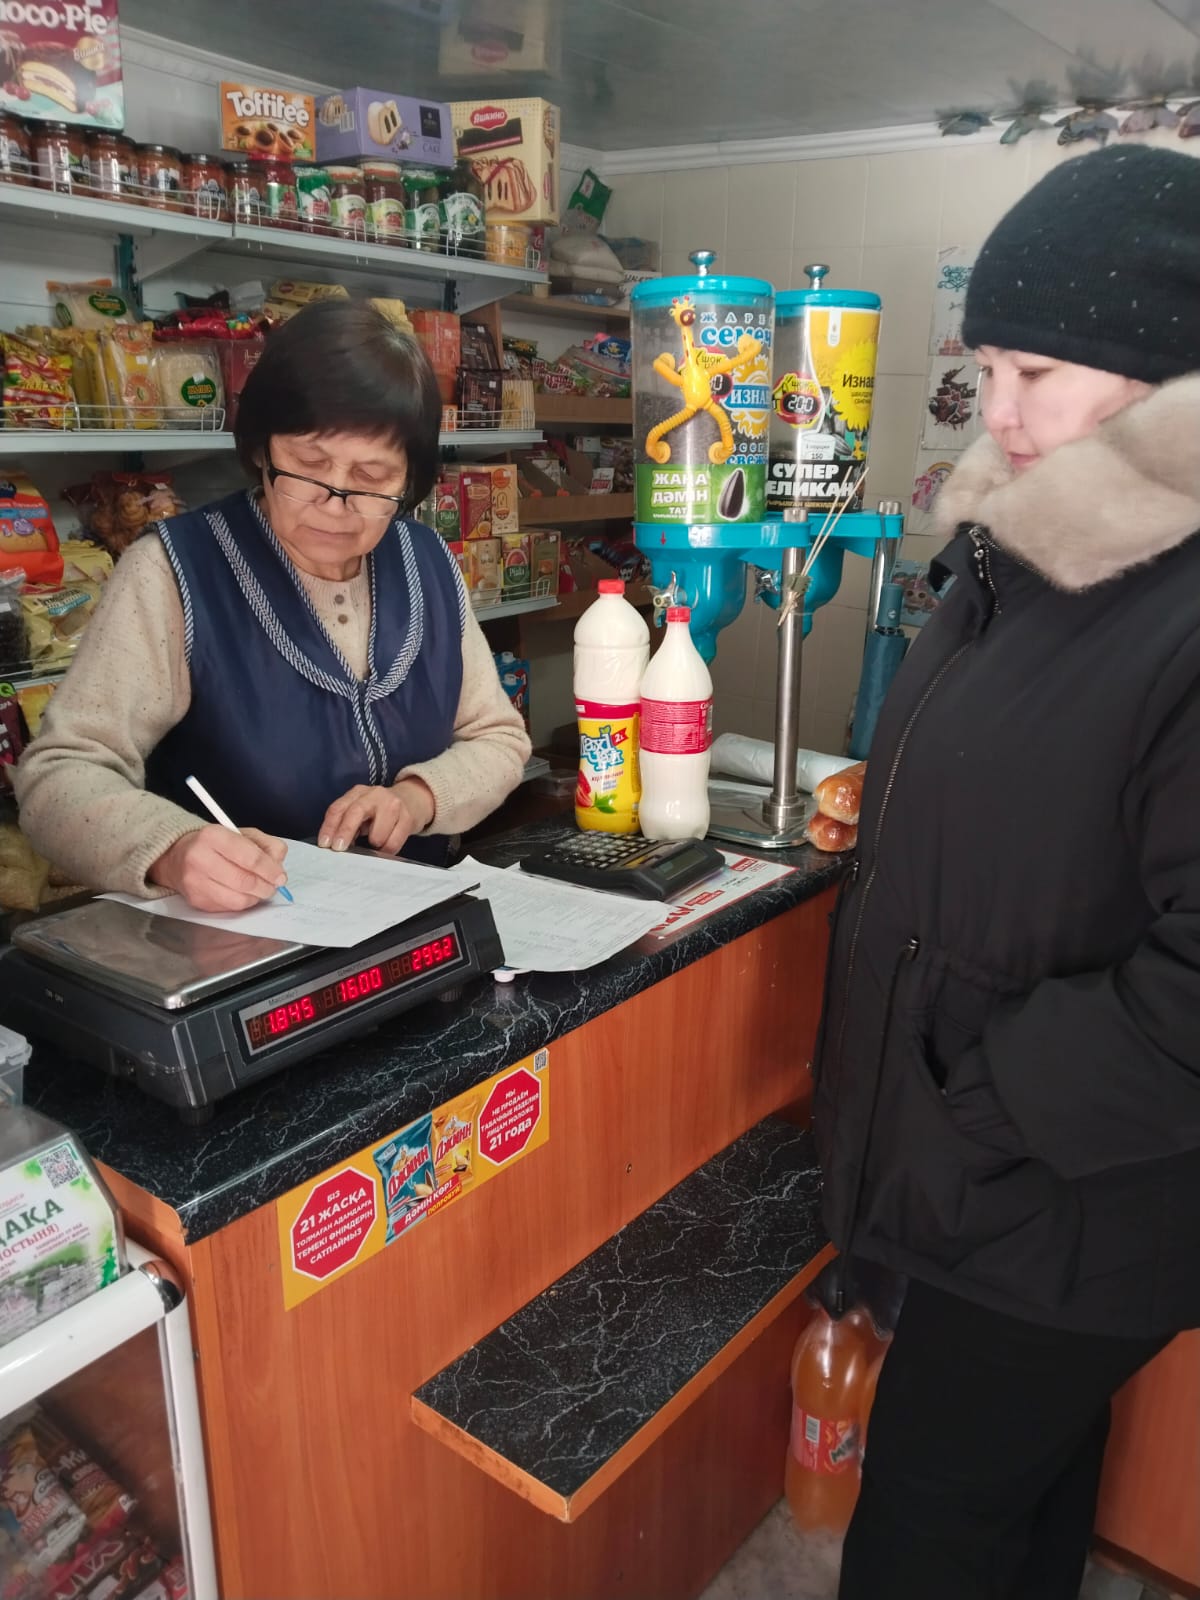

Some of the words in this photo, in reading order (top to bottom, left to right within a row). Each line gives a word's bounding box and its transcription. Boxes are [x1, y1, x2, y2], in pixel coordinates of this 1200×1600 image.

[226, 91, 309, 127] Toffifee
[788, 394, 814, 412] 200
[772, 462, 840, 479] СУПЕР
[765, 480, 854, 497] ЕЛИКАН
[269, 995, 315, 1035] 1.845
[340, 966, 383, 1002] 1600
[411, 935, 453, 972] 2952
[505, 1088, 516, 1100] МЫ
[492, 1107, 500, 1116] НЕ
[436, 1122, 472, 1165] ДЖИНН
[489, 1133, 502, 1152] 21
[388, 1145, 429, 1204] ДЖИНН
[327, 1190, 341, 1203] БІЗ
[405, 1196, 432, 1225] ДӘМІН
[300, 1215, 316, 1235] 21
[297, 1237, 328, 1260] ТЕМЕКІ
[310, 1227, 362, 1264] САТПАЙМЫЗ
